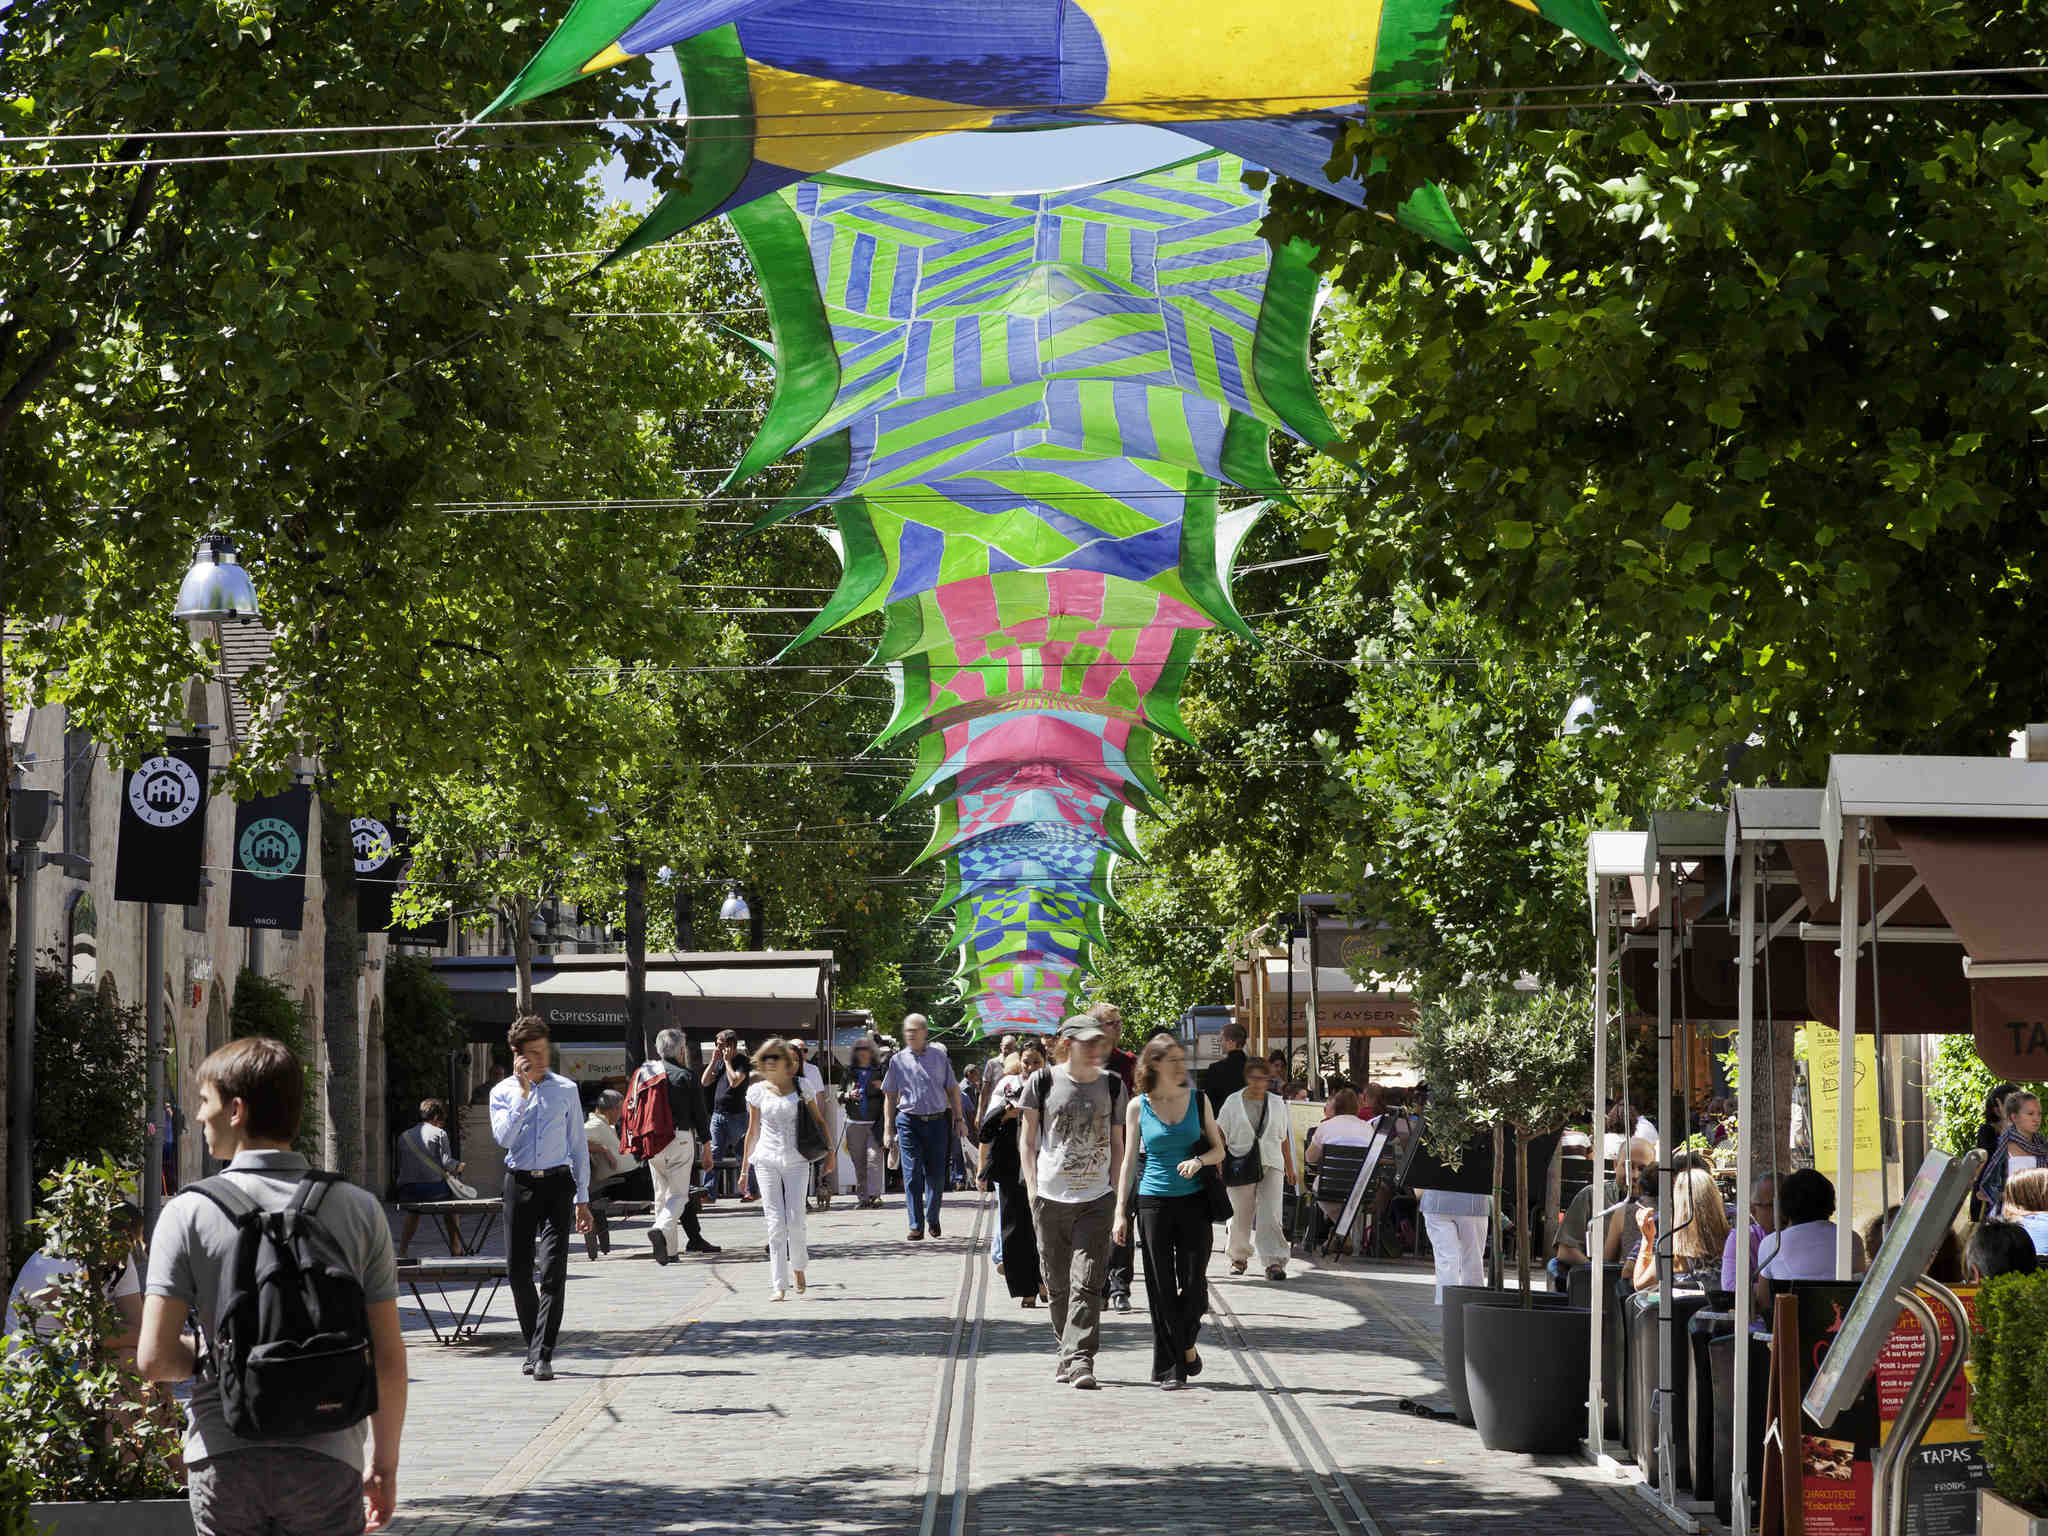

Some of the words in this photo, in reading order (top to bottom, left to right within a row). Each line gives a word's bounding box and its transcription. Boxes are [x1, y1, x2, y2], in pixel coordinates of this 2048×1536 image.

[139, 760, 193, 779] BERCY
[132, 792, 196, 824] VILLAGE
[247, 821, 296, 838] BERCY
[351, 818, 386, 834] ERCY
[1291, 1010, 1327, 1020] ERC
[1333, 1010, 1395, 1020] KAYSER
[1920, 1447, 1972, 1464] TAPAS
